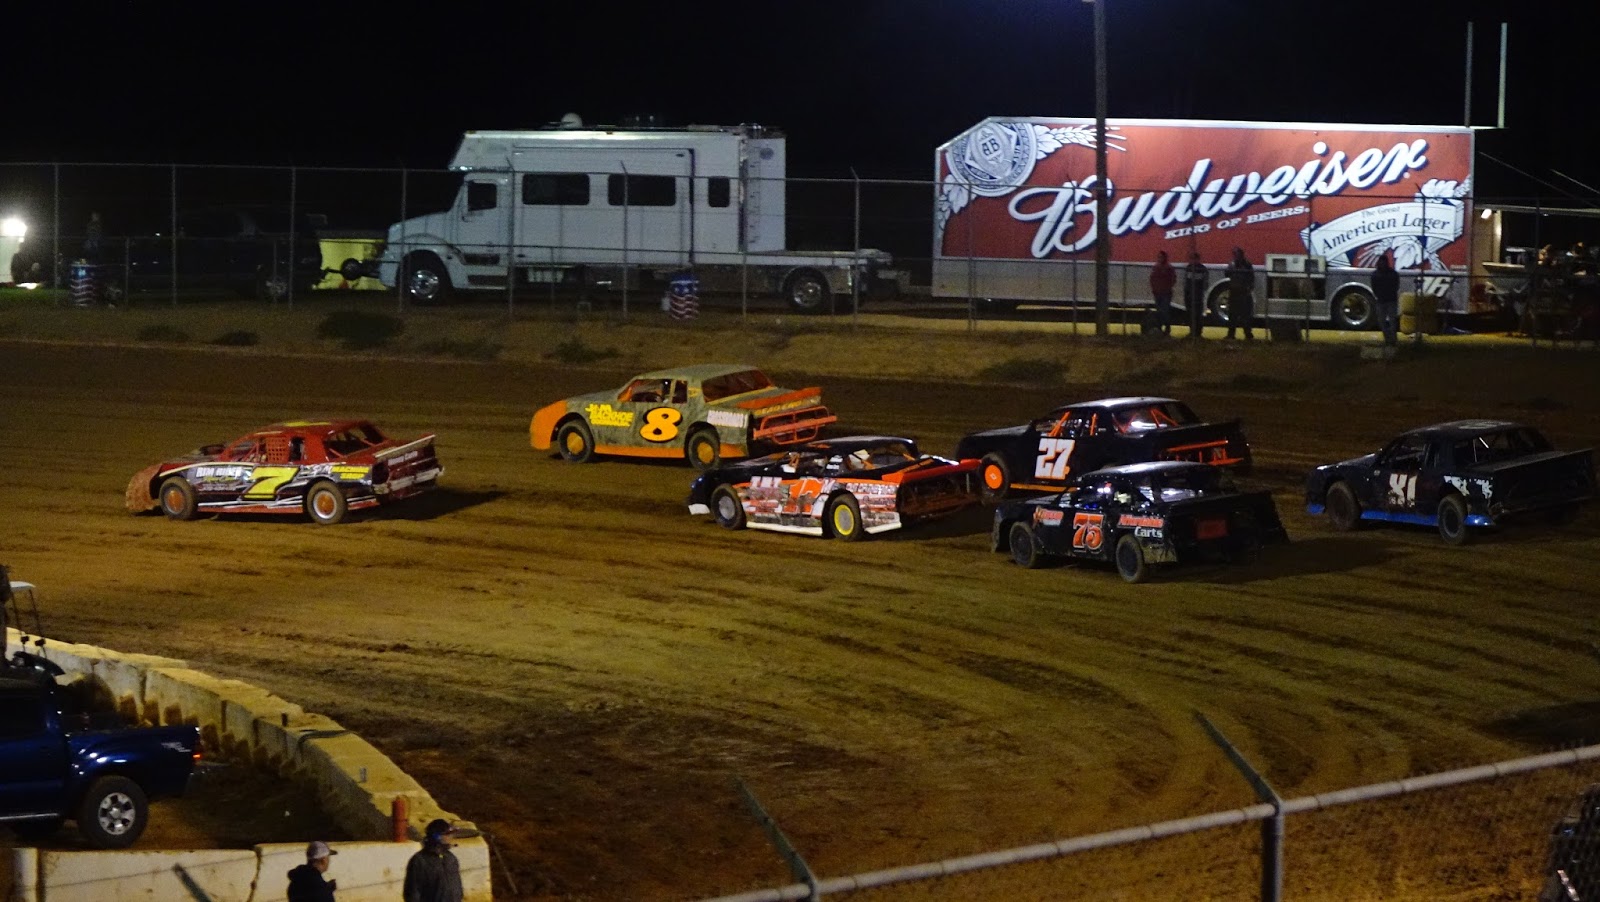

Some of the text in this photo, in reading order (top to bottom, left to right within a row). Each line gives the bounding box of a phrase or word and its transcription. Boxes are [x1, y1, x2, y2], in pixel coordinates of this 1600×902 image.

[1008, 138, 1427, 258] Budweiser
[1164, 223, 1211, 240] KING
[1216, 217, 1242, 230] OF
[1321, 213, 1450, 253] American Lager
[640, 407, 683, 443] 8
[1034, 438, 1076, 480] 27
[243, 466, 299, 499] 7
[1072, 512, 1105, 551] 75
[1135, 526, 1163, 539] Carts
